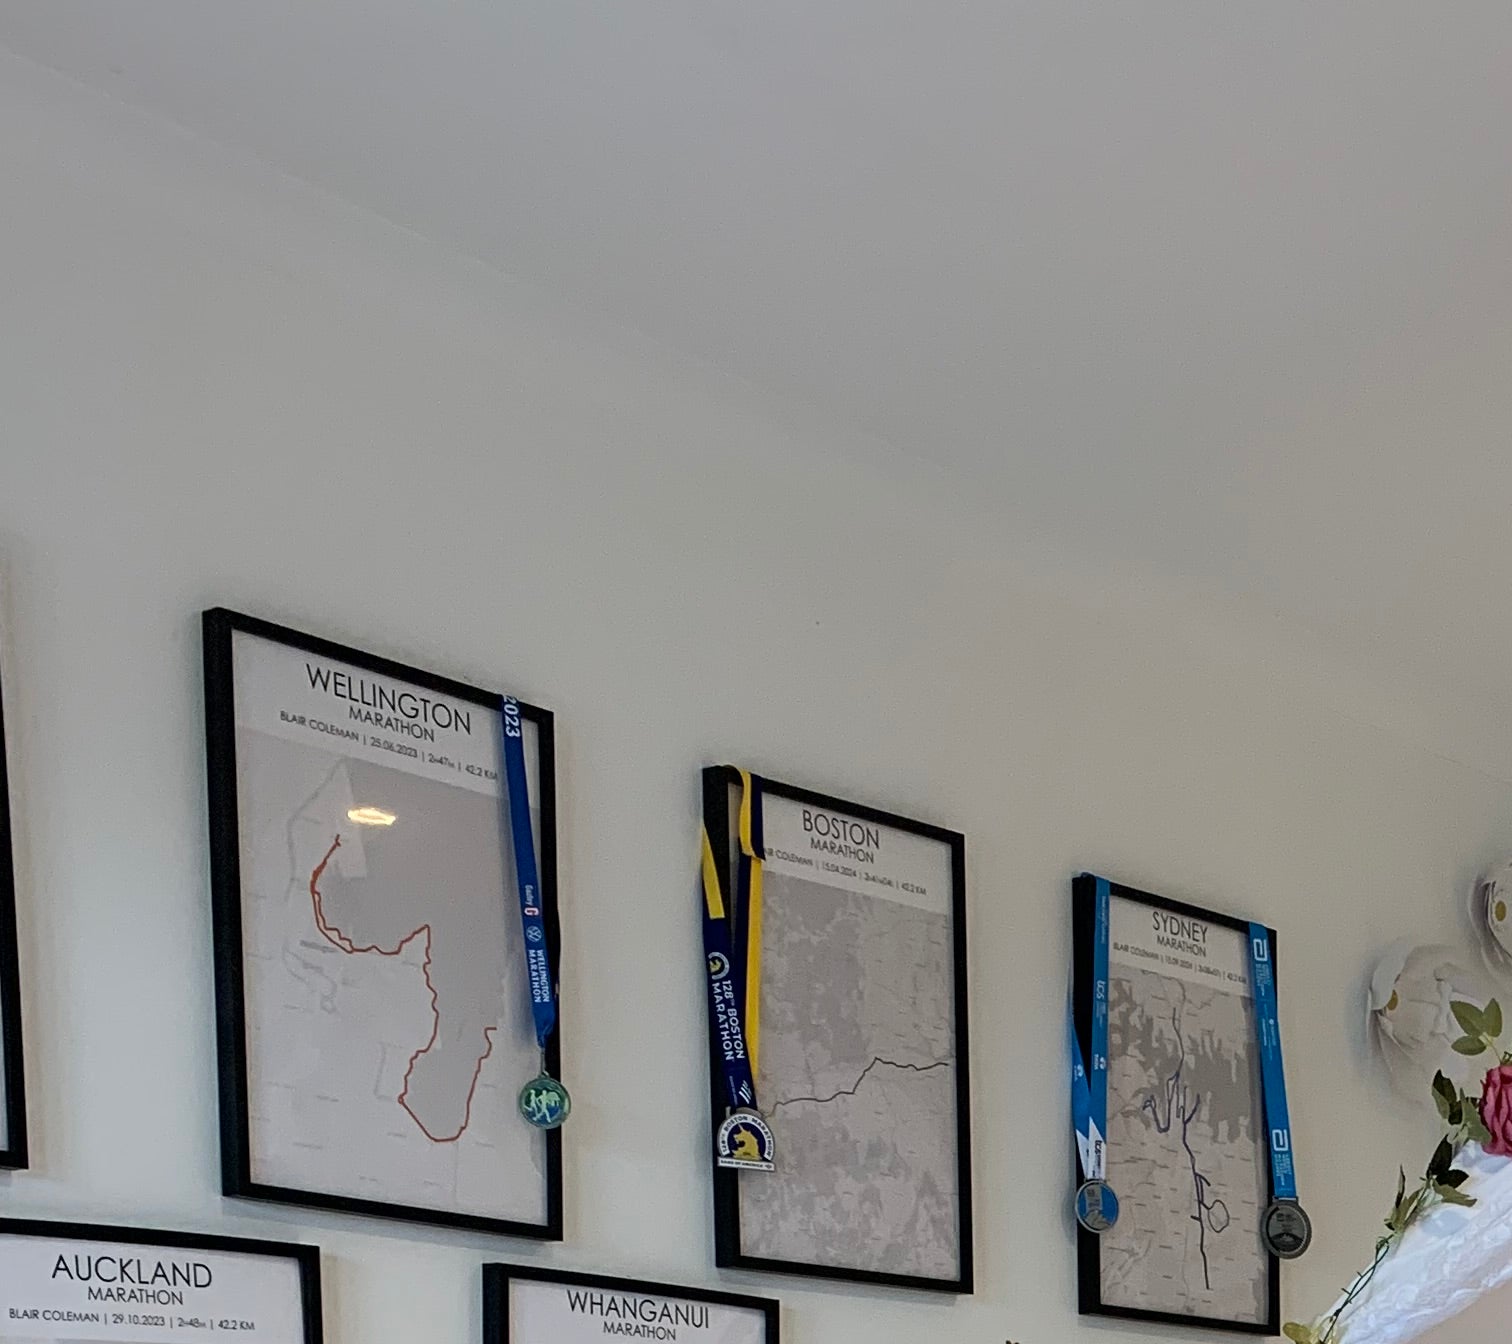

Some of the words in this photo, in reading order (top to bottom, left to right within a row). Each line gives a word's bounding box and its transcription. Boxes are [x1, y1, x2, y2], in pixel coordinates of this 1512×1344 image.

[306, 663, 471, 735] WELLINGTON
[503, 695, 522, 738] 2023
[280, 710, 306, 727] BLAIR
[308, 719, 359, 742] COLEMAN
[348, 705, 435, 742] MARATHON
[802, 809, 880, 849] BOSTON
[810, 838, 875, 864] MARATHON
[1152, 911, 1208, 944] SYDNEY
[1157, 935, 1206, 958] MARATHON
[528, 949, 542, 1003] MARATHON
[536, 949, 550, 1002] WELLINGTON
[711, 981, 735, 1062] MARATHON
[727, 1007, 746, 1059] BOSTON
[51, 1254, 213, 1288] AUCKLAND
[87, 1286, 184, 1305] MARATHON
[567, 1289, 709, 1329] WHANGANUI
[9, 1308, 39, 1320] BLAIR
[42, 1309, 100, 1323] COLEMAN
[112, 1313, 165, 1327] 29.10.2023
[240, 1320, 255, 1330] KM
[603, 1321, 676, 1341] MARATHON
